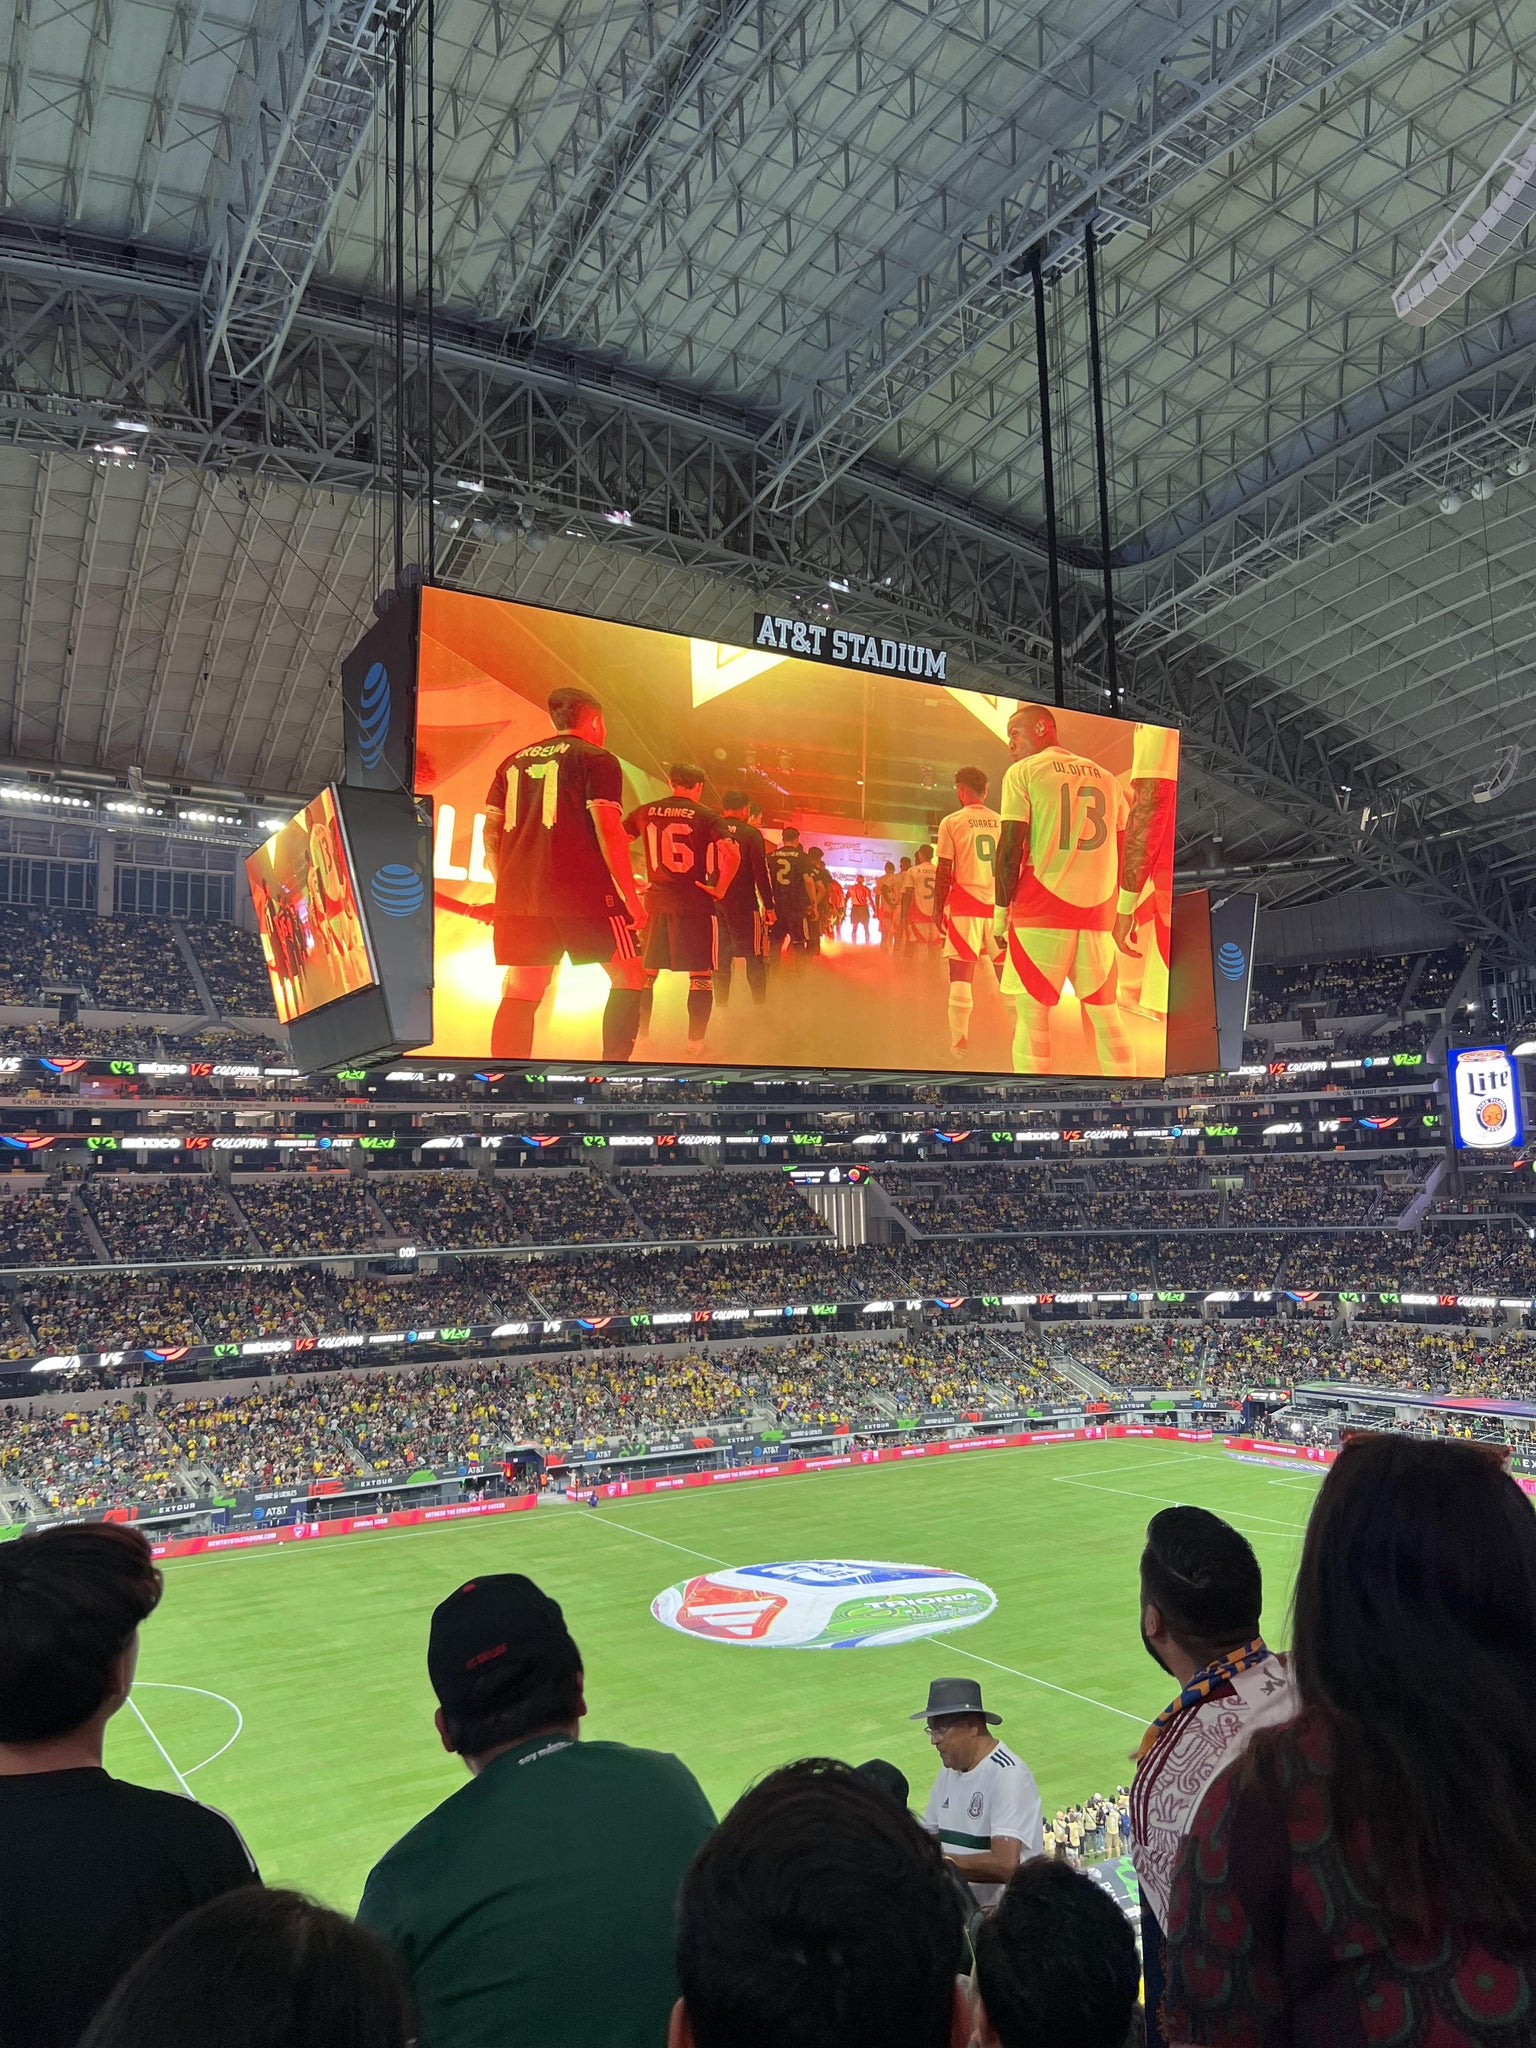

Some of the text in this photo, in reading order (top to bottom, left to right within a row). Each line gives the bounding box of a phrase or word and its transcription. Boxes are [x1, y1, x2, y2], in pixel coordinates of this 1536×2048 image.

[757, 615, 947, 680] AT&T STADIUM
[1053, 760, 1102, 779] W.DITTA
[1059, 782, 1109, 851] 13
[968, 818, 999, 829] SUAREZ
[647, 823, 695, 873] 16
[976, 834, 996, 877] 9
[776, 858, 791, 885] 2
[190, 1063, 211, 1076] VS
[212, 1065, 260, 1077] COLOMBIA
[1268, 1063, 1287, 1075] VS
[1287, 1061, 1327, 1072] COLOMBIA
[1467, 1071, 1508, 1096] Lite
[1318, 1120, 1340, 1132] VS
[656, 1136, 675, 1146] VS
[677, 1136, 721, 1146] COLOMBIA
[901, 1133, 920, 1143] VS
[1062, 1131, 1081, 1141] VS
[1083, 1130, 1128, 1140] COLOMBIA
[185, 1137, 209, 1149] VS
[211, 1138, 269, 1149] COLOMBIA
[332, 1139, 354, 1147] AT&T
[480, 1136, 502, 1148] VS
[1038, 1294, 1054, 1305] VS
[1054, 1294, 1093, 1303] COLOMBIA
[1253, 1291, 1273, 1302] VS
[1439, 1295, 1457, 1306] VS
[1457, 1296, 1496, 1307] COLOMBIA
[693, 1310, 712, 1322] VS
[712, 1309, 750, 1320] COLOMBIA
[543, 1321, 562, 1333] VS
[295, 1338, 318, 1351] VS
[317, 1335, 364, 1348] COLOMBIA
[100, 1352, 125, 1366] VS
[595, 1450, 612, 1459] AT&T
[762, 1446, 780, 1455] AT&T
[467, 1465, 486, 1475] AT&T
[354, 1477, 393, 1488] MEXTOUR
[151, 1502, 196, 1515] MEXTOUR
[266, 1505, 288, 1517] AT&T
[425, 1510, 446, 1519] WITNESS
[456, 1505, 481, 1515] EVOLUTION
[354, 1520, 374, 1528] COMING
[862, 1593, 978, 1609] TRIONDA
